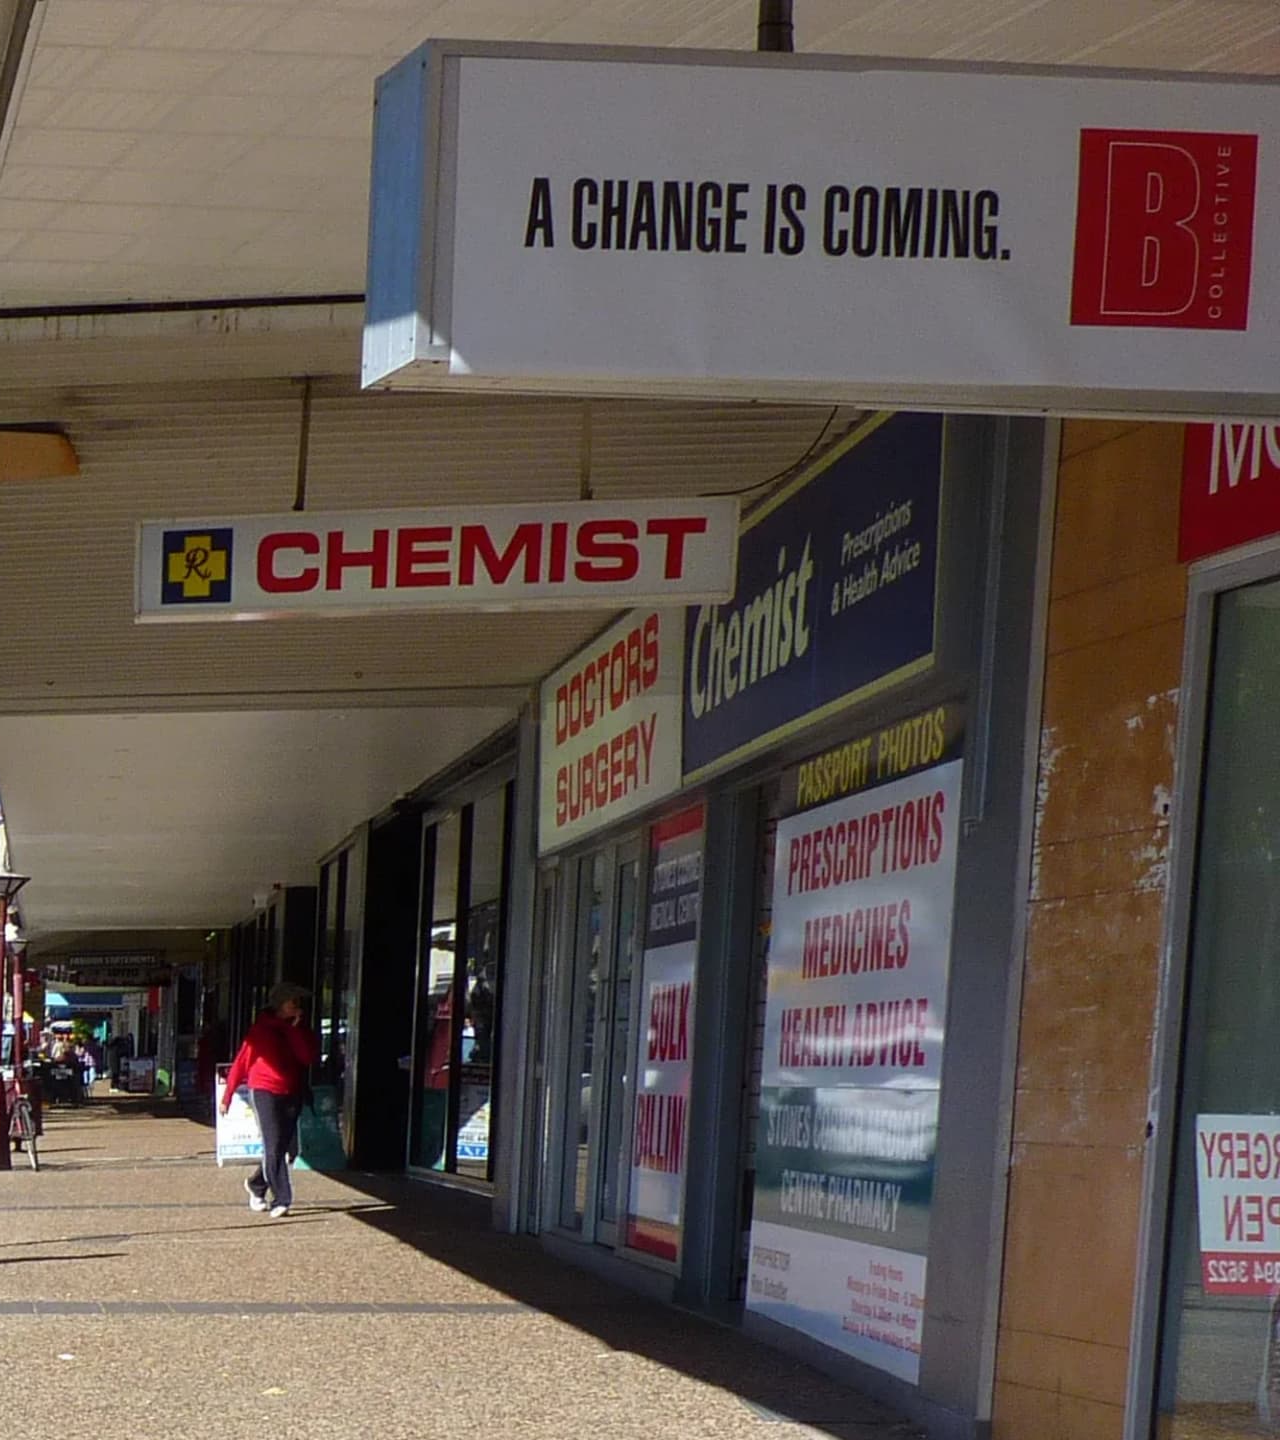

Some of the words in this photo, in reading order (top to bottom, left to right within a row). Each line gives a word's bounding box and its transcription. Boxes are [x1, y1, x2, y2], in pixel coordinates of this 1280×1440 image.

[525, 178, 554, 247] A
[572, 178, 749, 253] CHANGE
[764, 184, 806, 255] IS
[823, 186, 1010, 260] COMING.
[1100, 142, 1200, 315] B
[1208, 144, 1233, 319] COLLECTIVE
[257, 517, 707, 593] CHEMIST
[841, 499, 914, 566] Prescriptions
[831, 582, 839, 616] &
[841, 561, 878, 610] Health
[879, 540, 921, 588] Advice
[691, 532, 814, 719] Chemist
[556, 613, 659, 745] DOCTORS
[556, 712, 657, 827] SURGERY
[797, 735, 872, 808] PASSPORT
[877, 707, 945, 778] PHOTOS
[788, 790, 945, 897] PRESCRIPTIONS
[802, 899, 911, 980] MEDICINES
[648, 981, 690, 1061] BULK
[780, 1004, 846, 1067] HEALTH
[849, 998, 928, 1067] ADVICE
[768, 1104, 811, 1149] STONES
[781, 1168, 827, 1218] CENTRE
[827, 1175, 902, 1233] PHARMACY
